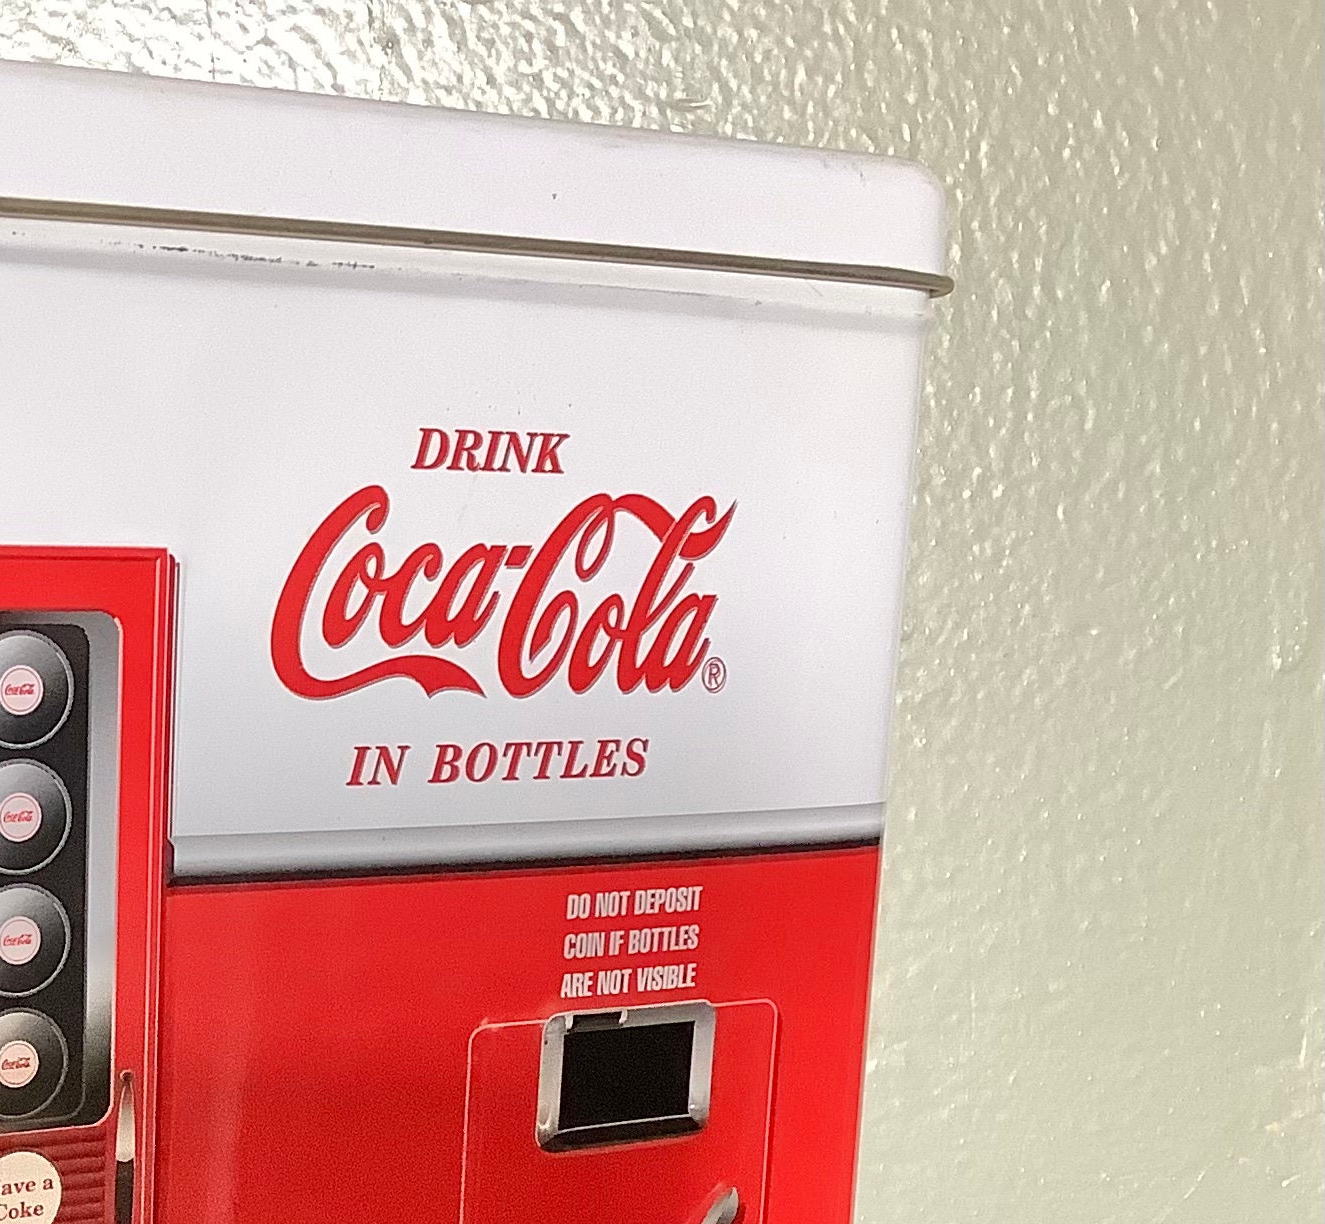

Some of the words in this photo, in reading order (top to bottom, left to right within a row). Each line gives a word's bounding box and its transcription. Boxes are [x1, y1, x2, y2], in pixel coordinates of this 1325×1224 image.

[410, 427, 571, 474] DRINK
[270, 484, 738, 700] Coca-Cola
[346, 745, 411, 787] IN
[427, 738, 650, 783] BOTTLES
[566, 893, 591, 920] DO
[594, 890, 631, 918] NOT
[634, 886, 703, 915] DEPOSIT
[563, 931, 605, 960] COIN
[608, 930, 625, 956] IF
[627, 924, 700, 955] BOTTLES
[560, 971, 594, 999] ARE
[597, 968, 632, 996] NOT
[636, 963, 697, 992] VISIBLE
[42, 1178, 54, 1190] a
